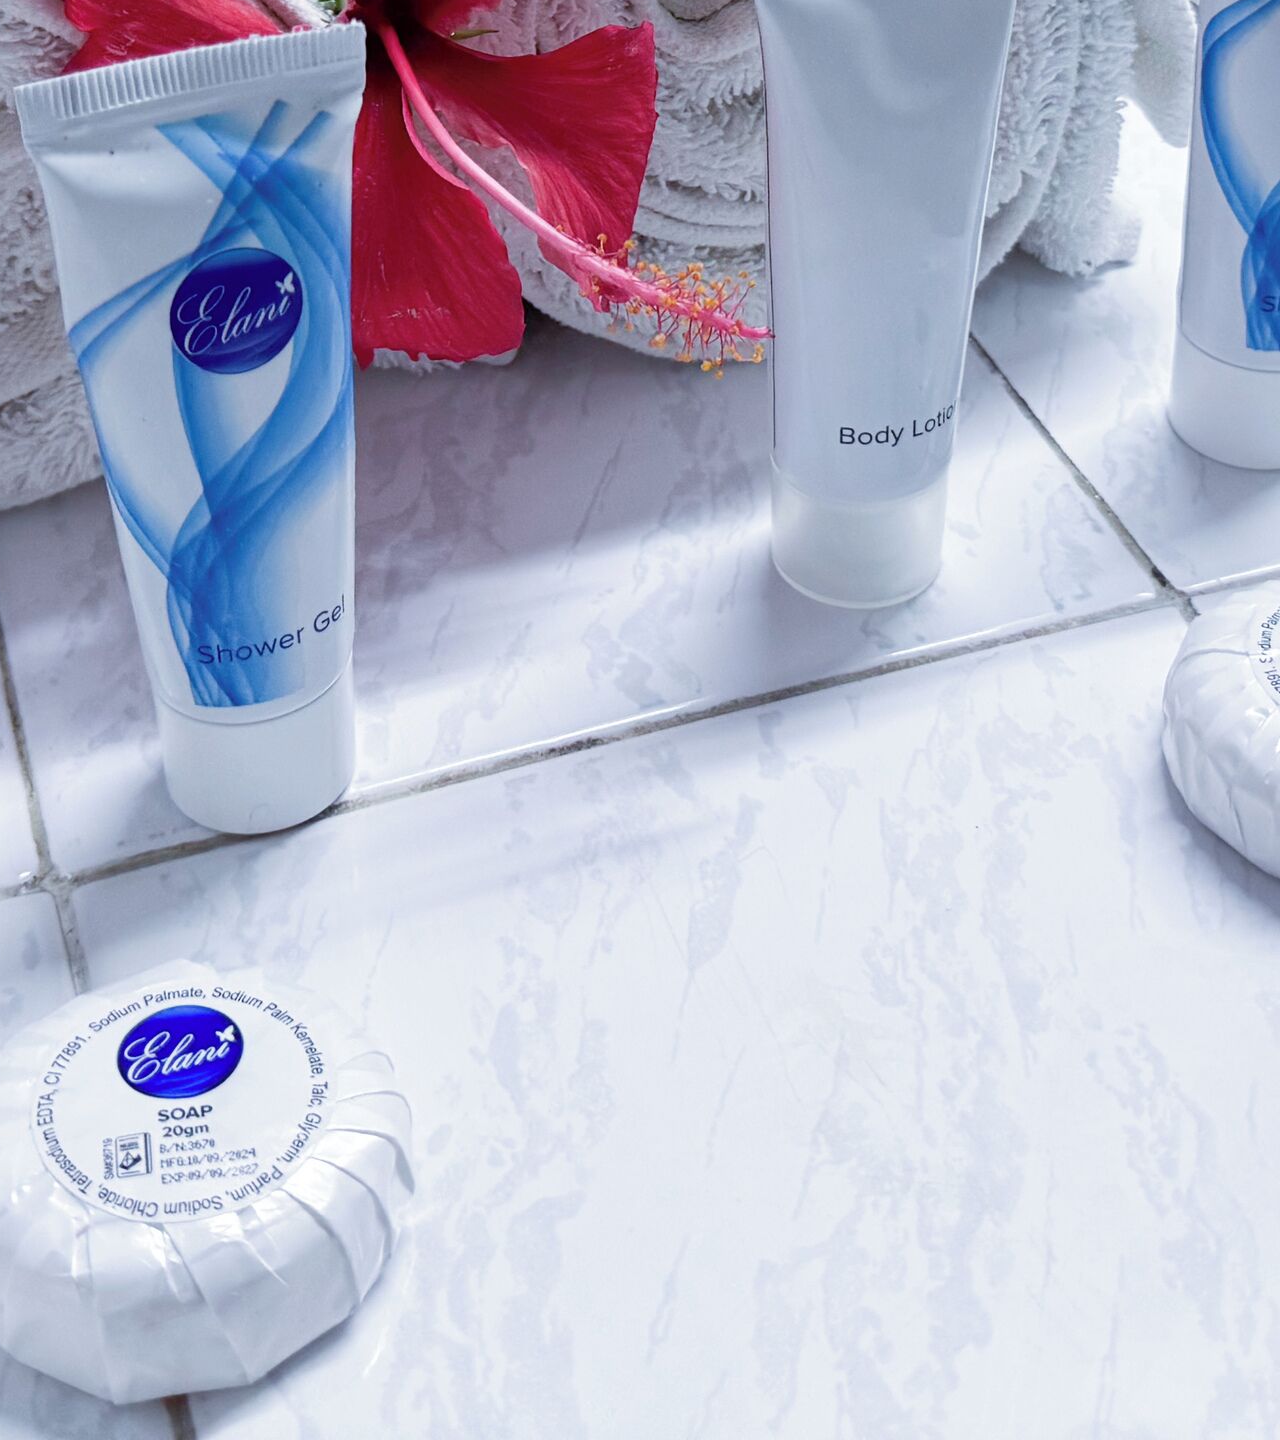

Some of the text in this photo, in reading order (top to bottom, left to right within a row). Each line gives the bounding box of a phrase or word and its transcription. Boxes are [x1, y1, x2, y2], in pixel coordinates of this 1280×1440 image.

[177, 271, 296, 356] Elani
[839, 400, 957, 448] Body Lotio
[197, 593, 346, 664] Shower Gel
[143, 986, 207, 1007] Palmate,
[211, 986, 264, 1009] Sodium
[263, 1001, 295, 1026] Palm
[88, 1001, 142, 1033] Sodium
[123, 1025, 236, 1084] Elani
[289, 1022, 325, 1079] Kernelate,
[43, 1071, 63, 1086] CI
[308, 1081, 329, 1108] Talc,
[37, 1088, 59, 1127] EDTA,
[157, 1104, 214, 1122] SOAP
[162, 1123, 210, 1138] 20gm
[276, 1112, 323, 1168] Glycerin,
[42, 1127, 93, 1195] Tetrasodium
[97, 1183, 159, 1218] Chloride,
[225, 1164, 284, 1202] Parfum,
[163, 1195, 224, 1216] Sodium
